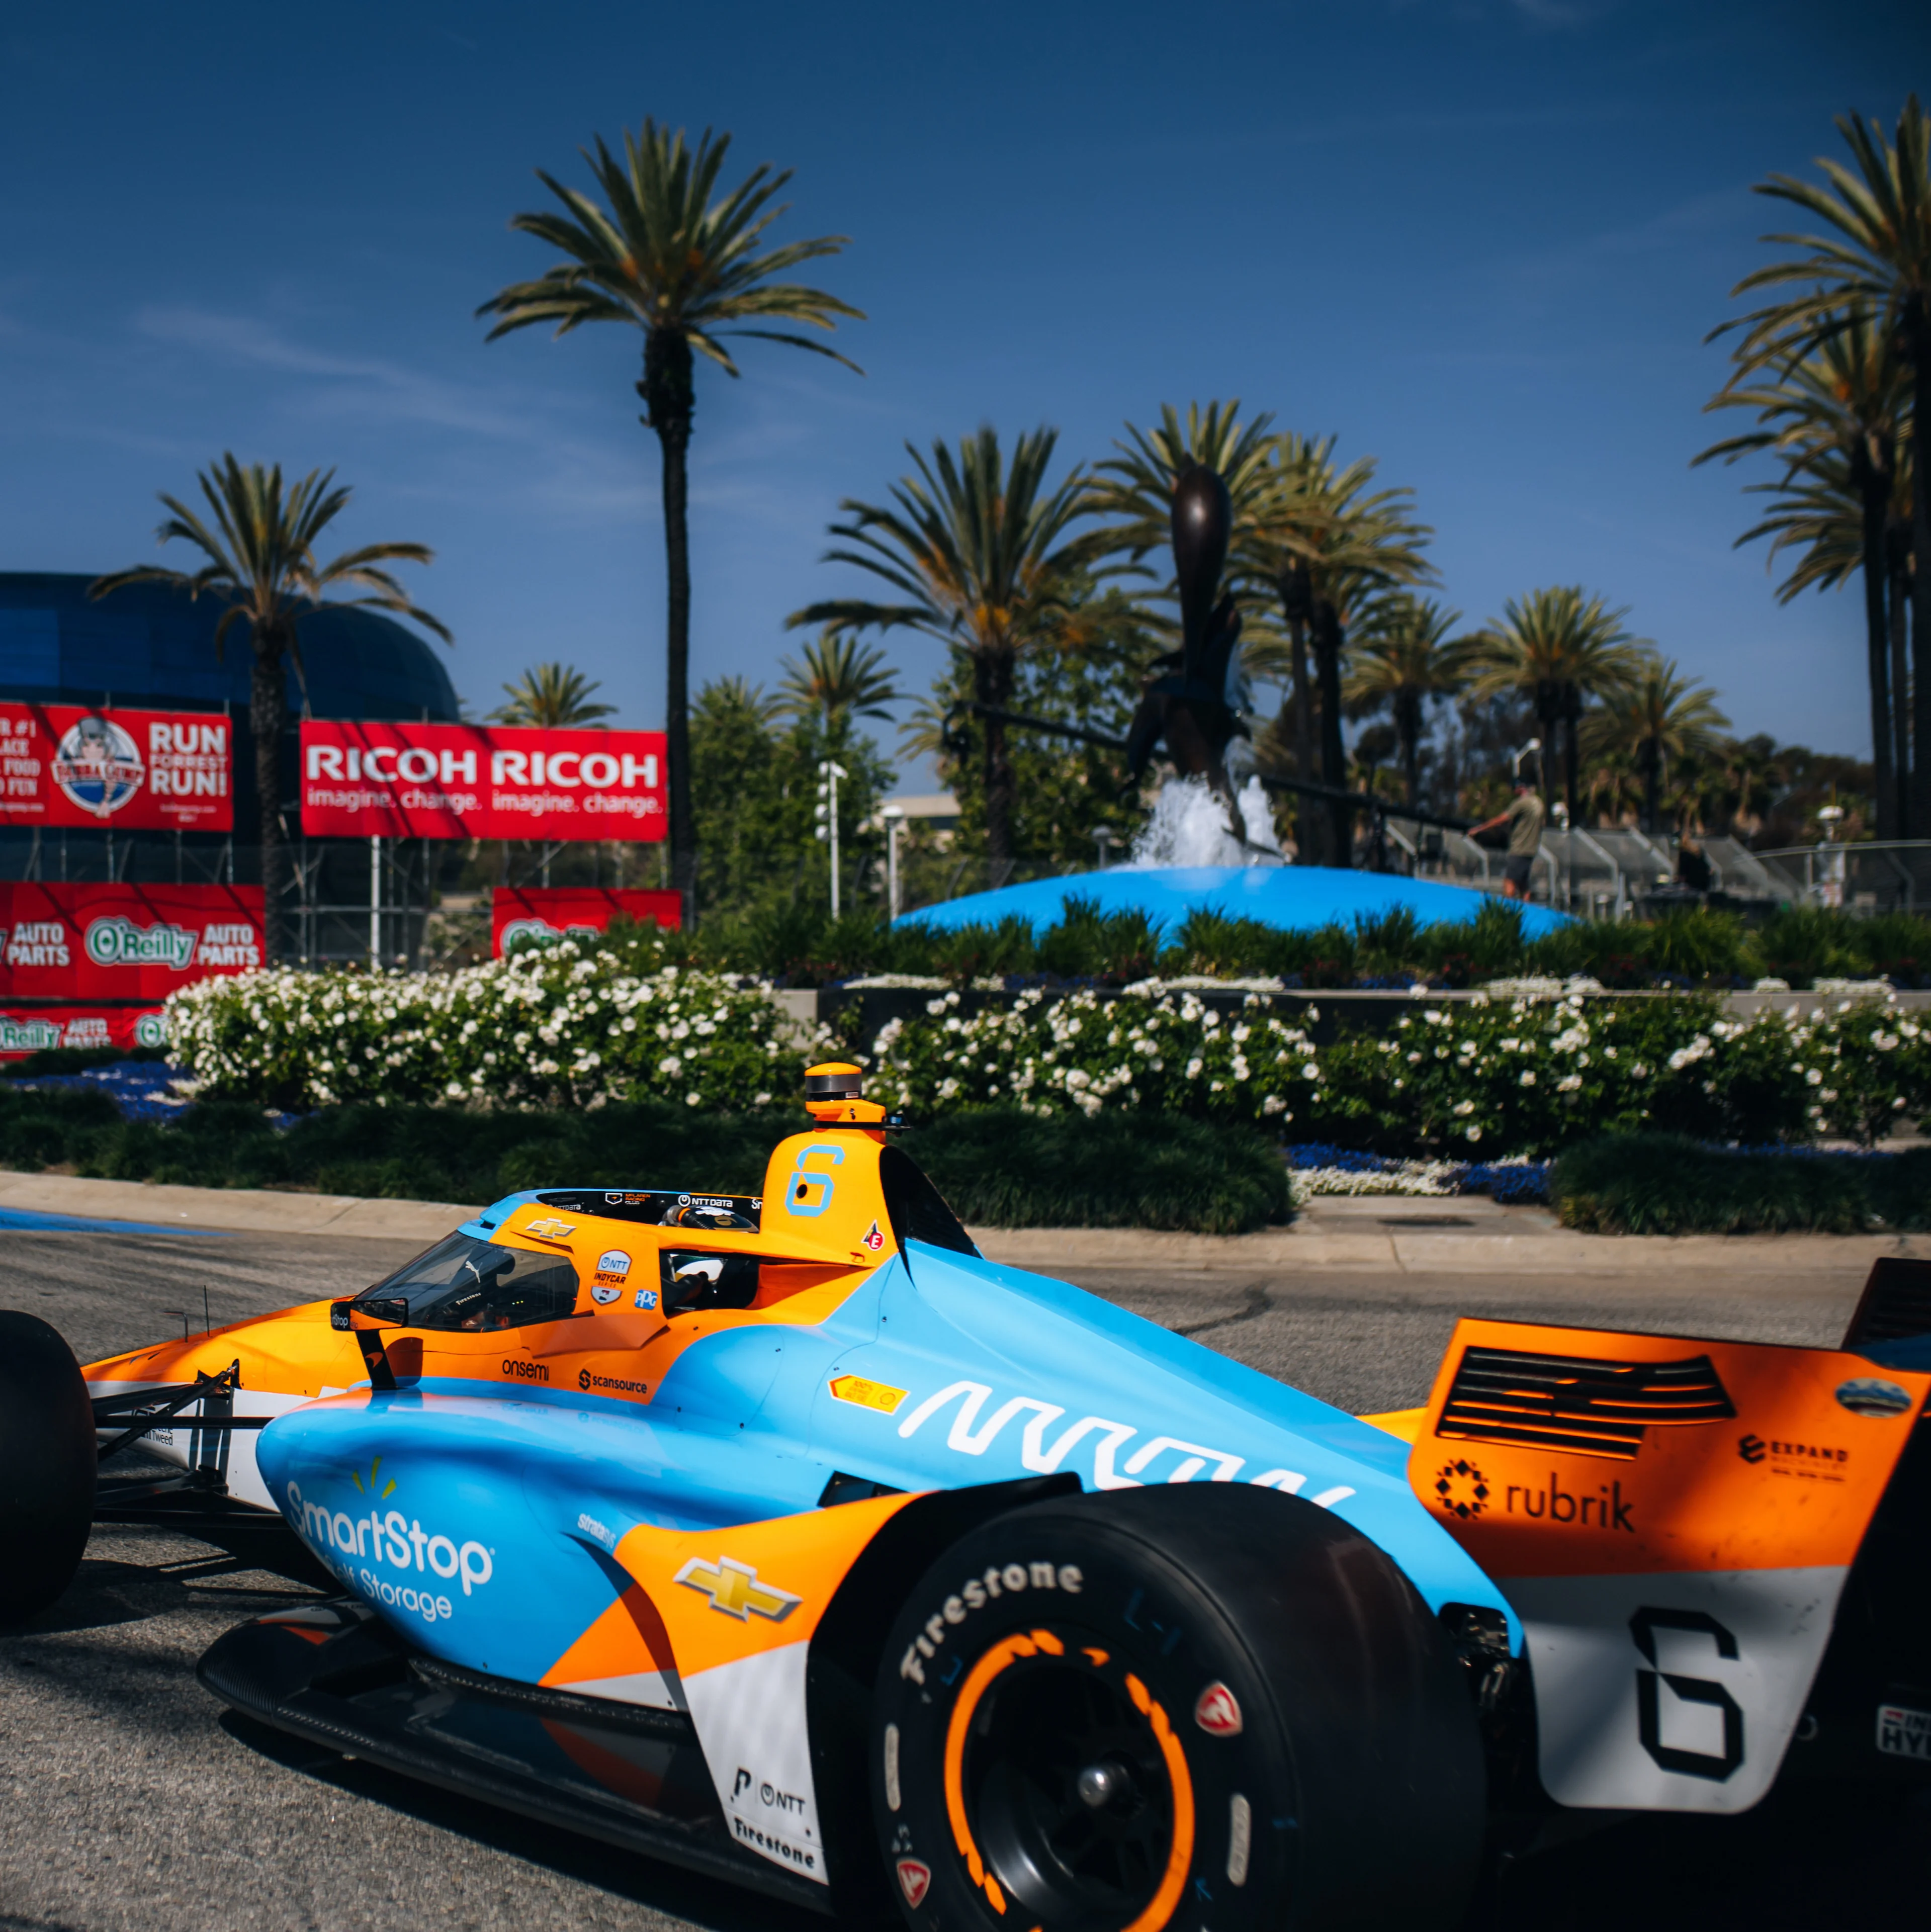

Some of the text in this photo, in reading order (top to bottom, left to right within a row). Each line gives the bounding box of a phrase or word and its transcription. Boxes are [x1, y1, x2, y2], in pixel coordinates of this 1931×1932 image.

[0, 738, 29, 756] ACE
[149, 722, 226, 754] RUN
[150, 754, 227, 770] FORREST
[306, 745, 658, 788] RICOH RICOH
[149, 769, 227, 797] RUN!
[307, 785, 482, 815] imagine. change.
[492, 789, 663, 818] imagine. change.
[14, 922, 64, 944] AUTO
[92, 923, 193, 962] O'Reilly
[204, 923, 254, 944] AUTO
[7, 945, 70, 966] PARTS
[198, 945, 259, 965] PARTS
[67, 1018, 107, 1035] AUTO
[784, 1144, 845, 1217] 6
[610, 1260, 628, 1270] NTT
[594, 1272, 626, 1284] INDYCAR
[635, 1290, 657, 1307] PPG
[502, 1359, 549, 1381] onsemi
[593, 1375, 647, 1394] scansource
[151, 1430, 173, 1446] Tweed
[1772, 1441, 1848, 1462] EXPAND
[1507, 1471, 1634, 1533] rubrik
[287, 1481, 493, 1596] SmartStop
[361, 1568, 452, 1622] Storage
[901, 1561, 1083, 1685] Firestone
[1628, 1606, 1744, 1783] 6
[776, 1790, 805, 1815] NTT
[734, 1816, 815, 1869] Firestone
